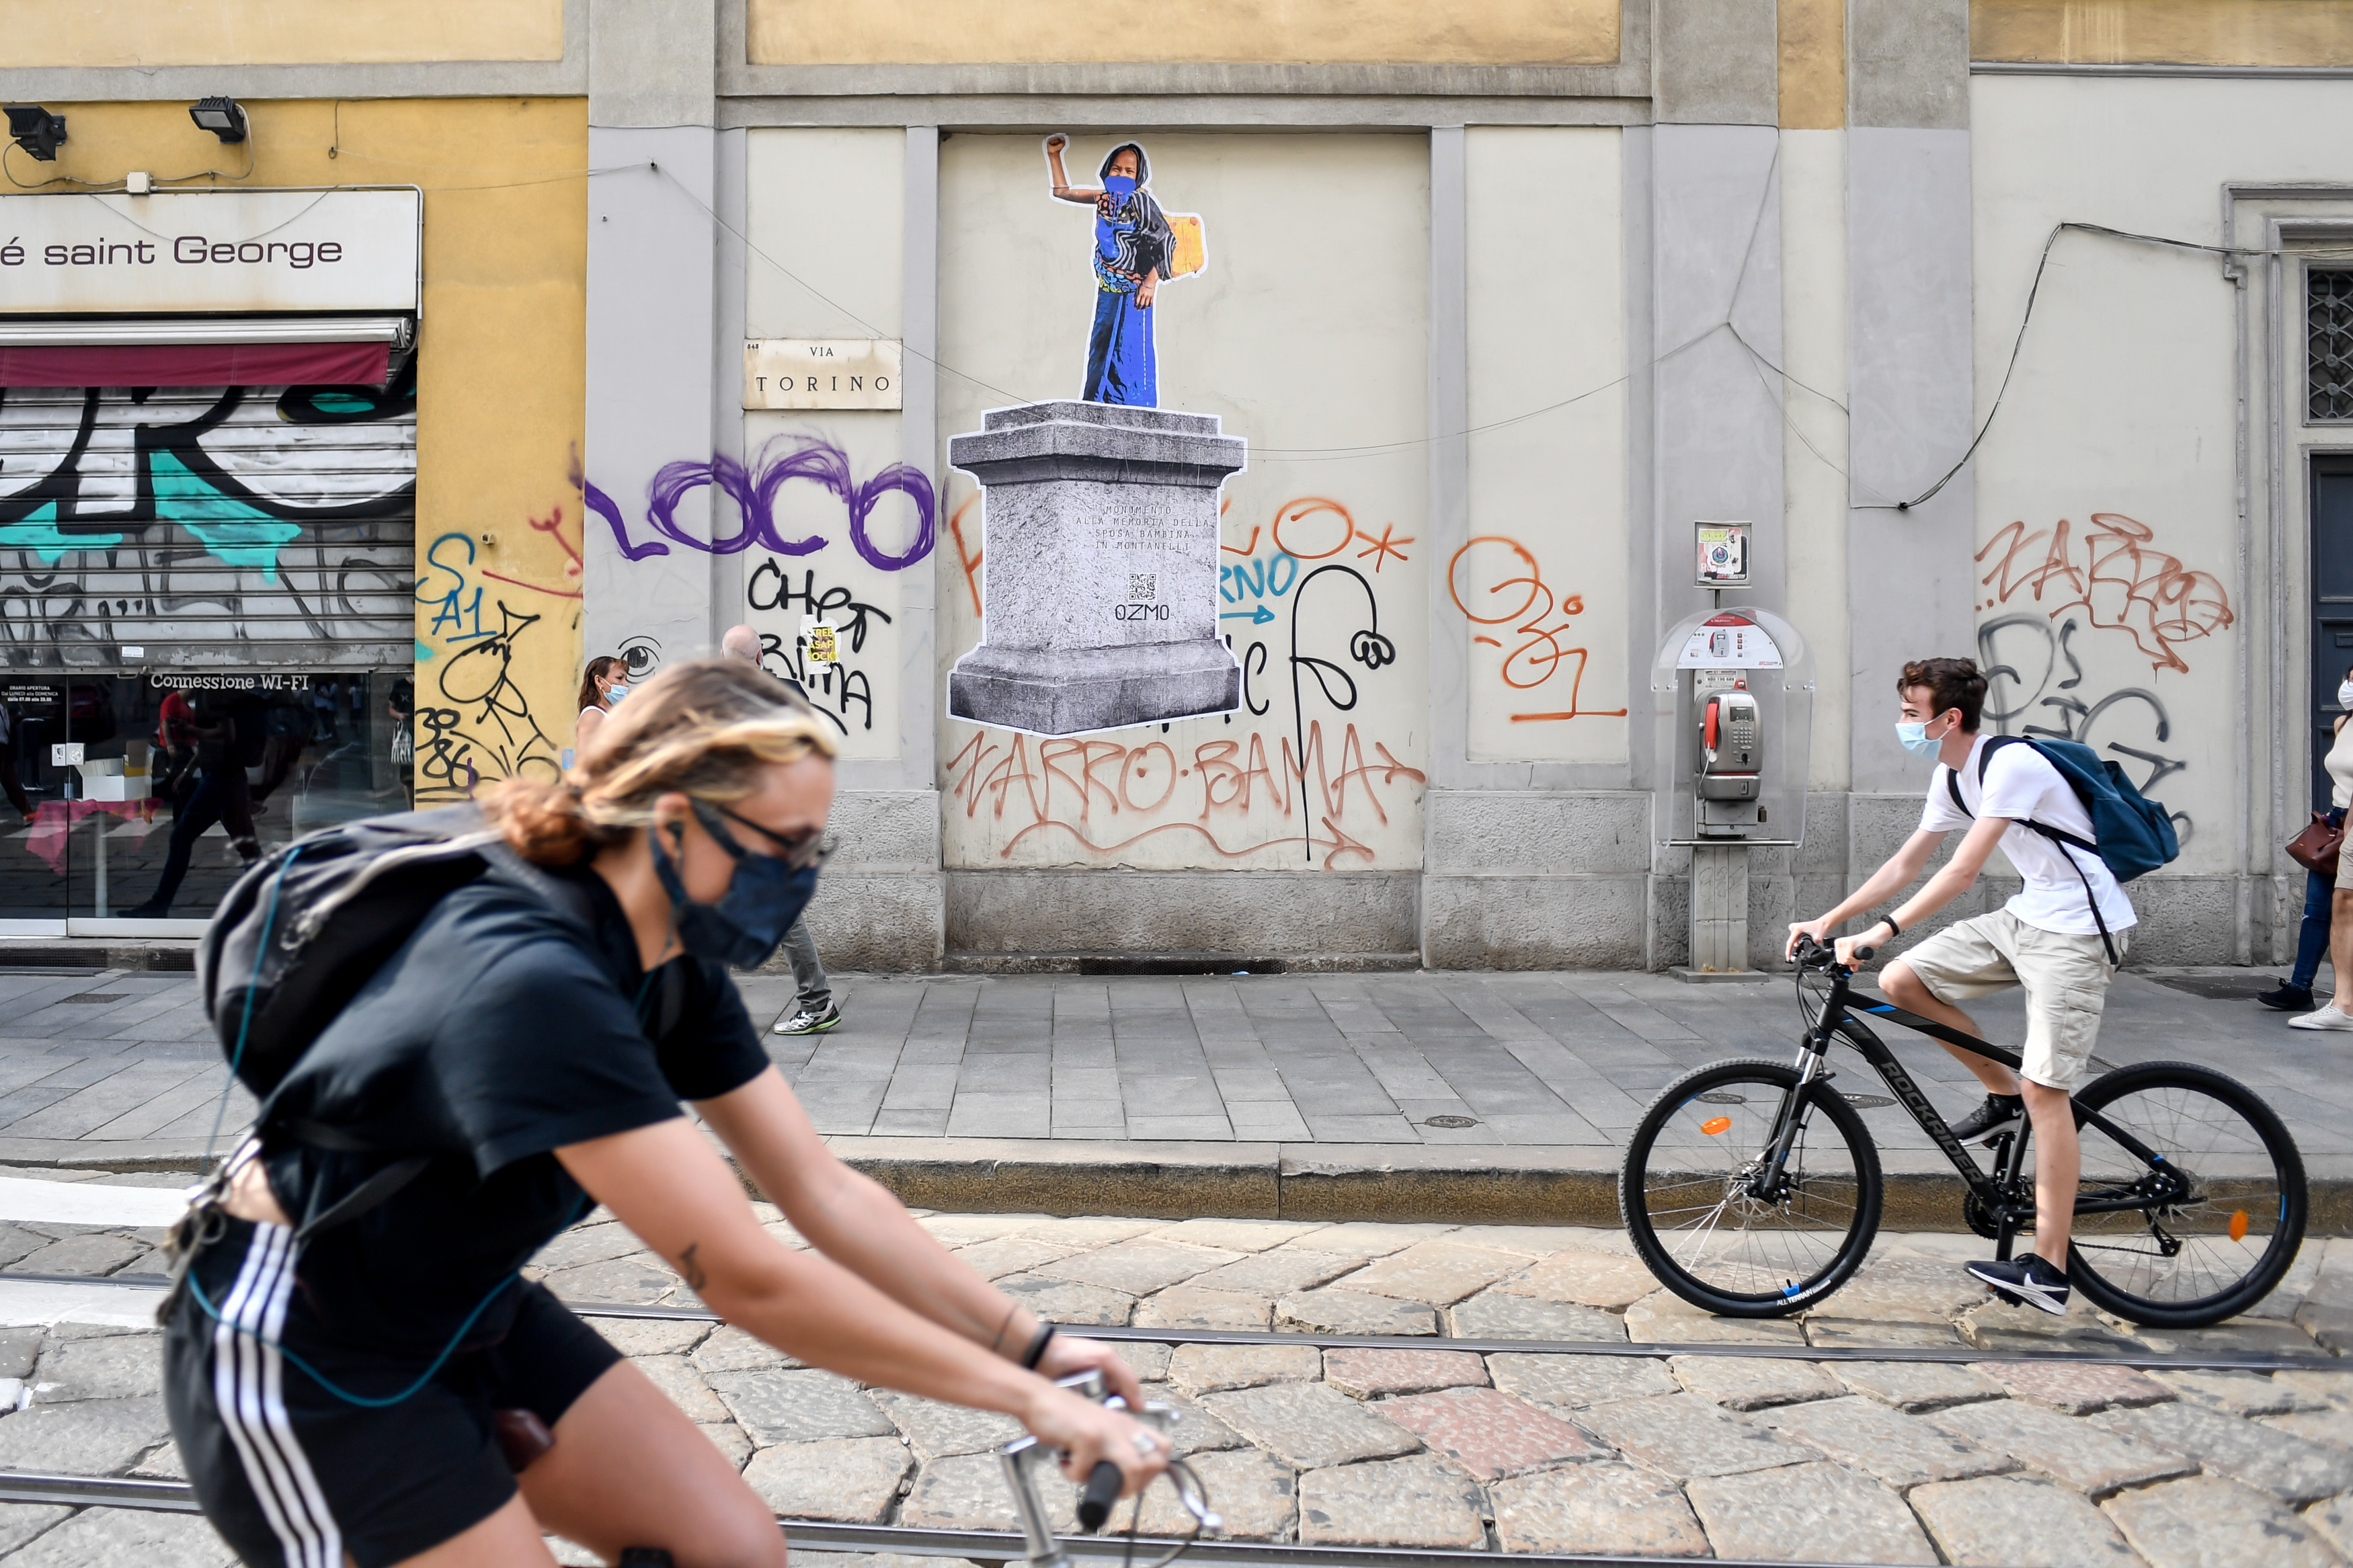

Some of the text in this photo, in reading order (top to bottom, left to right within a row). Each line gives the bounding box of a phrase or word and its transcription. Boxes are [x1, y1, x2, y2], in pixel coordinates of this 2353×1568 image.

[44, 237, 156, 265] saint
[173, 235, 342, 270] George
[809, 347, 834, 357] VIA
[756, 376, 889, 391] TORINO
[1105, 505, 1172, 515] MONUMENTO
[1076, 518, 1209, 528] ALLA MEMORIA DELLA
[1095, 529, 1190, 538] SPOSA BAMBINA
[1095, 541, 1189, 550] IN MONTANELLI
[1115, 604, 1170, 621] OZMO
[809, 640, 834, 650] ASAP
[151, 673, 309, 691] Connessione WI-FI
[1882, 1062, 1983, 1184] ROCKRIDER
[1777, 1288, 1813, 1307] ALL TERRAIN
